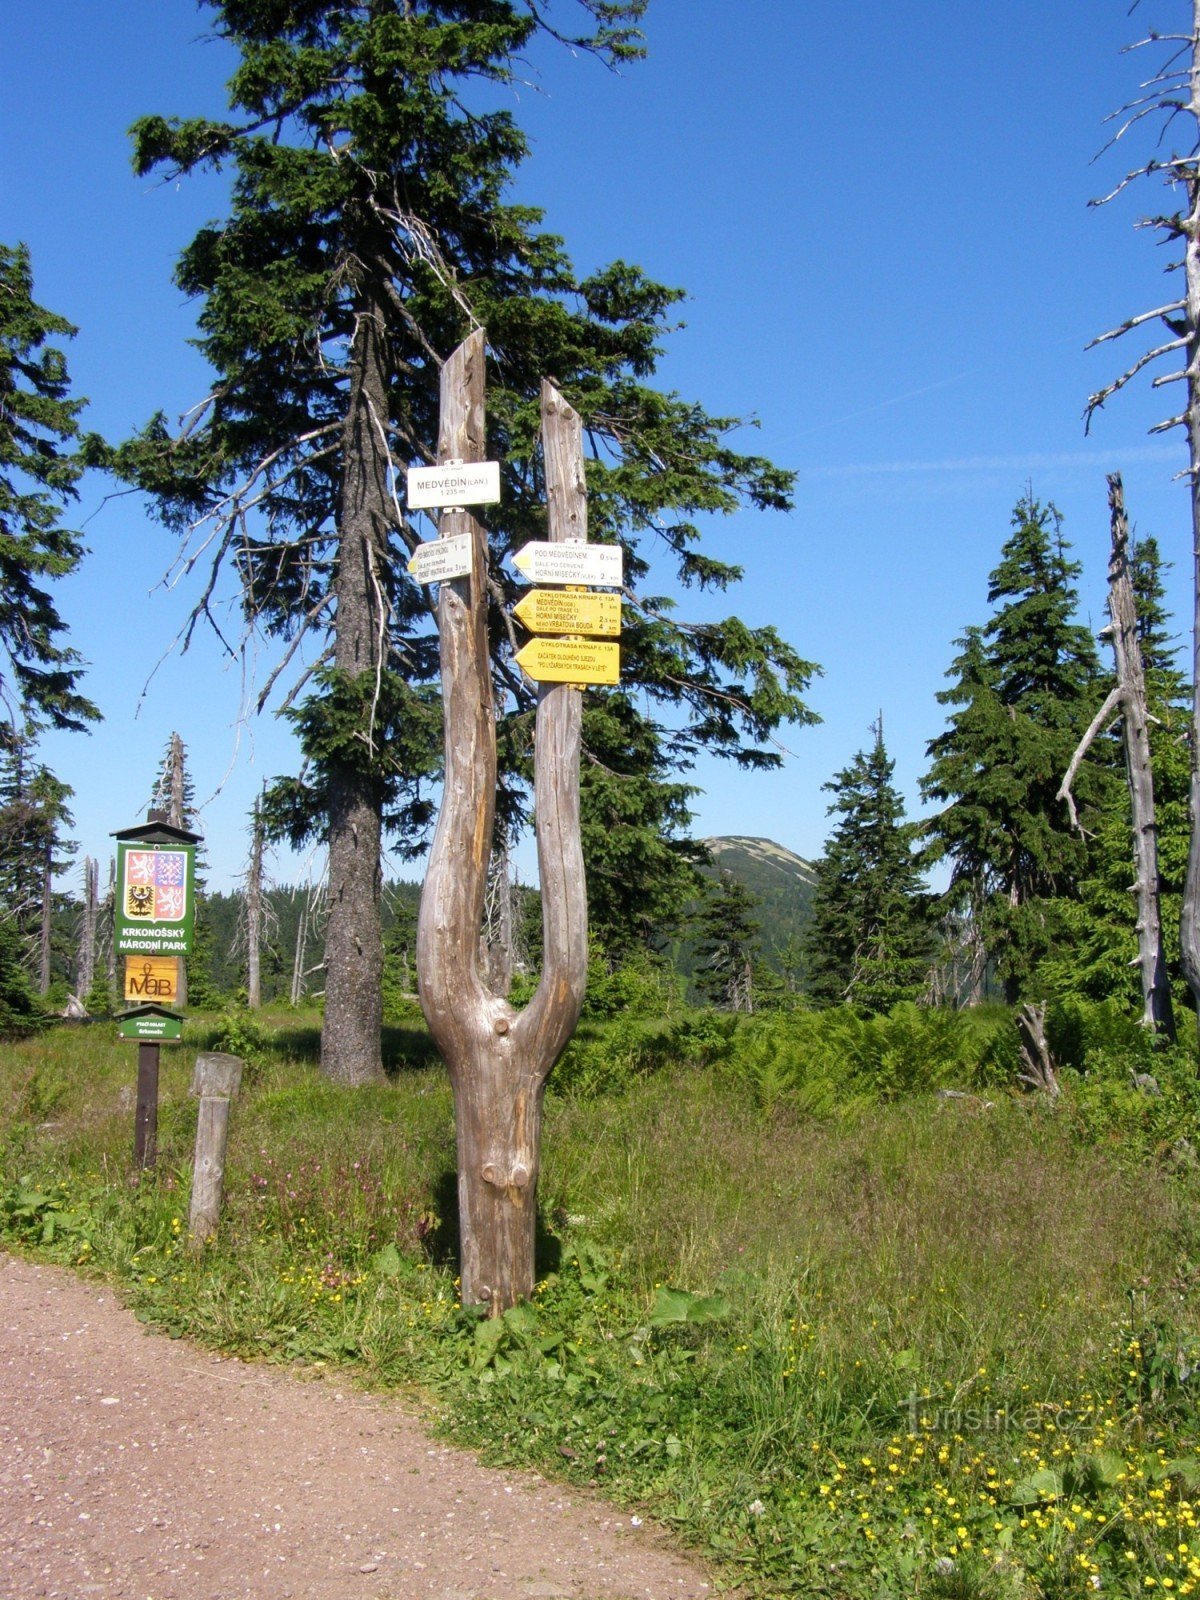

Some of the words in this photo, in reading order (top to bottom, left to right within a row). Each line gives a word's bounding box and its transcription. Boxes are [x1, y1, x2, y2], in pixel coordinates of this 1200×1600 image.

[417, 477, 467, 490] MEDVĚDÍN
[122, 928, 185, 938] KRKONOŠSKÝ
[120, 939, 160, 949] NÁRODNÍ
[163, 942, 187, 950] PARK
